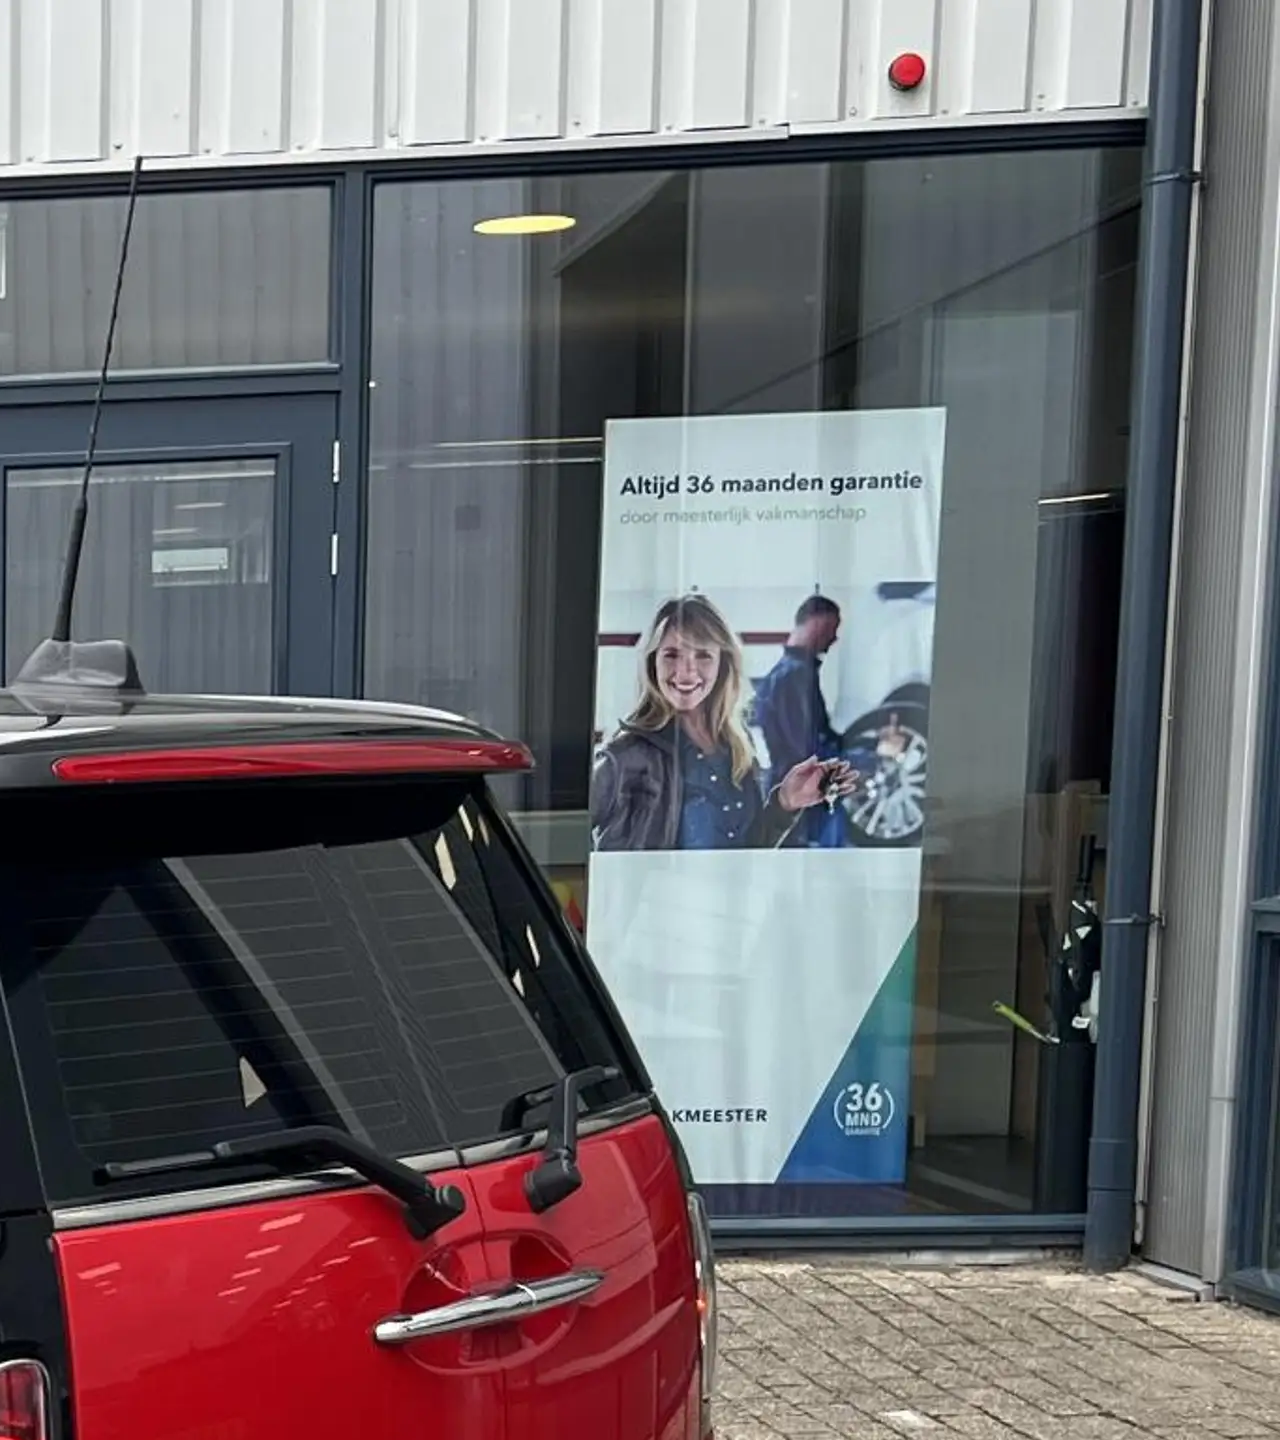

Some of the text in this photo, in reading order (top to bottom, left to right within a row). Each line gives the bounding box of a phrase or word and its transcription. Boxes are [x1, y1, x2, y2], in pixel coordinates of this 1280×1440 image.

[619, 470, 923, 500] Altijd 36 maanden garantie
[619, 503, 867, 526] door meesterlijk vakmanschap
[846, 1082, 883, 1112] 36
[671, 1108, 768, 1123] KMEESTER
[845, 1111, 882, 1127] MND
